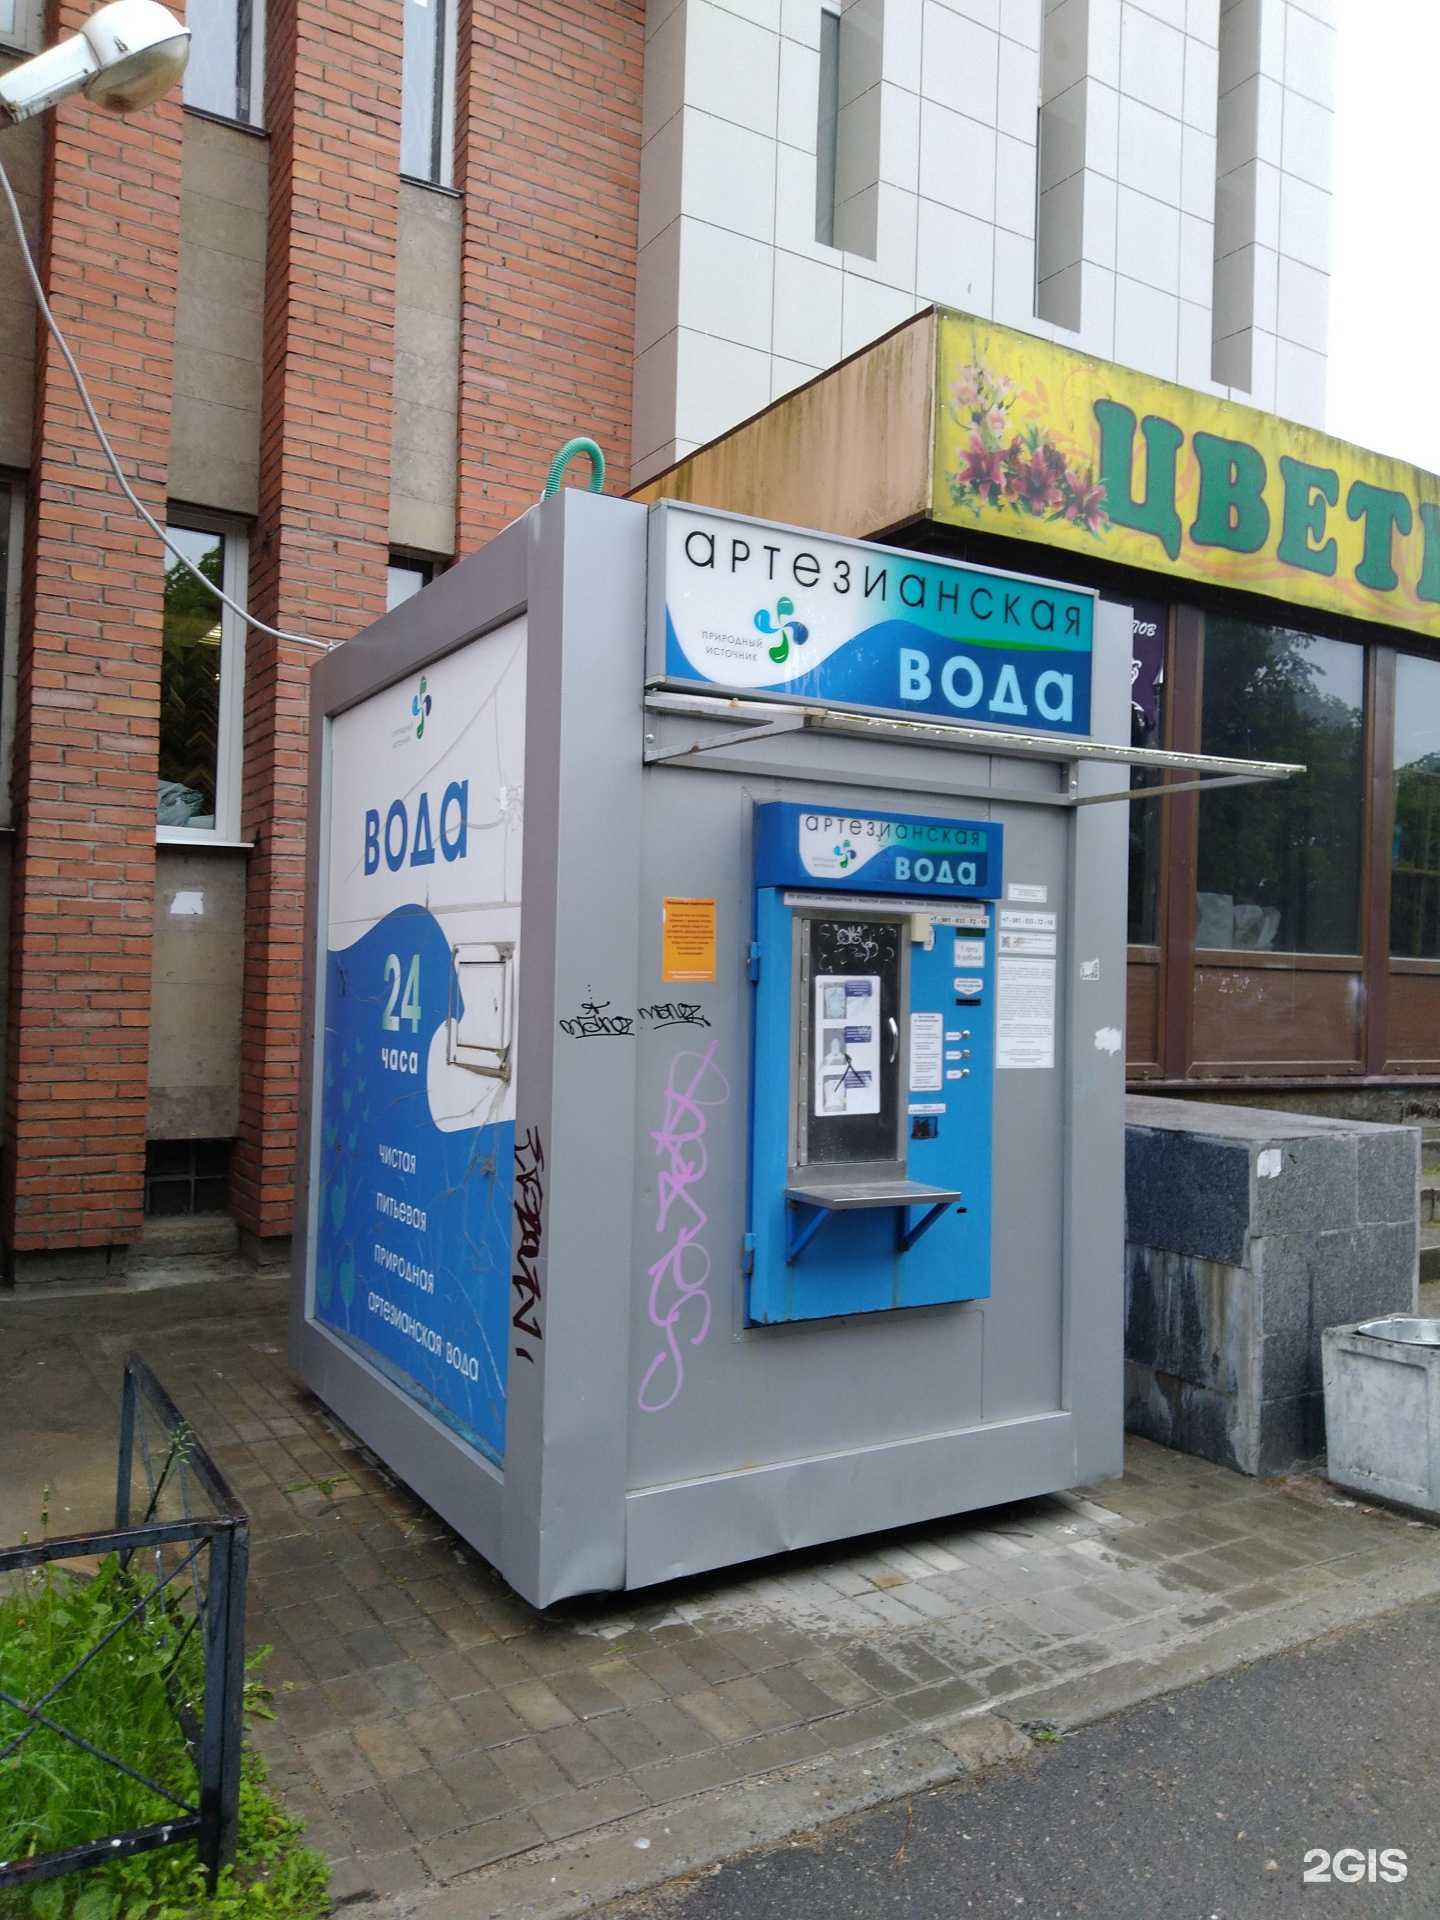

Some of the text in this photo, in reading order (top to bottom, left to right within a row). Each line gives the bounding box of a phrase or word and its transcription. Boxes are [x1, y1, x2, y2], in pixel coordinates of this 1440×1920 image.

[1093, 399, 1440, 602] ЦВЕТ
[685, 530, 1081, 637] артезианская
[805, 814, 980, 846] артезианская
[382, 953, 422, 1033] 24
[381, 1047, 418, 1075] часа
[378, 1143, 417, 1175] чистая
[376, 1191, 427, 1233] питьевая
[374, 1243, 435, 1295] природная
[368, 1290, 480, 1383] артезианская вода
